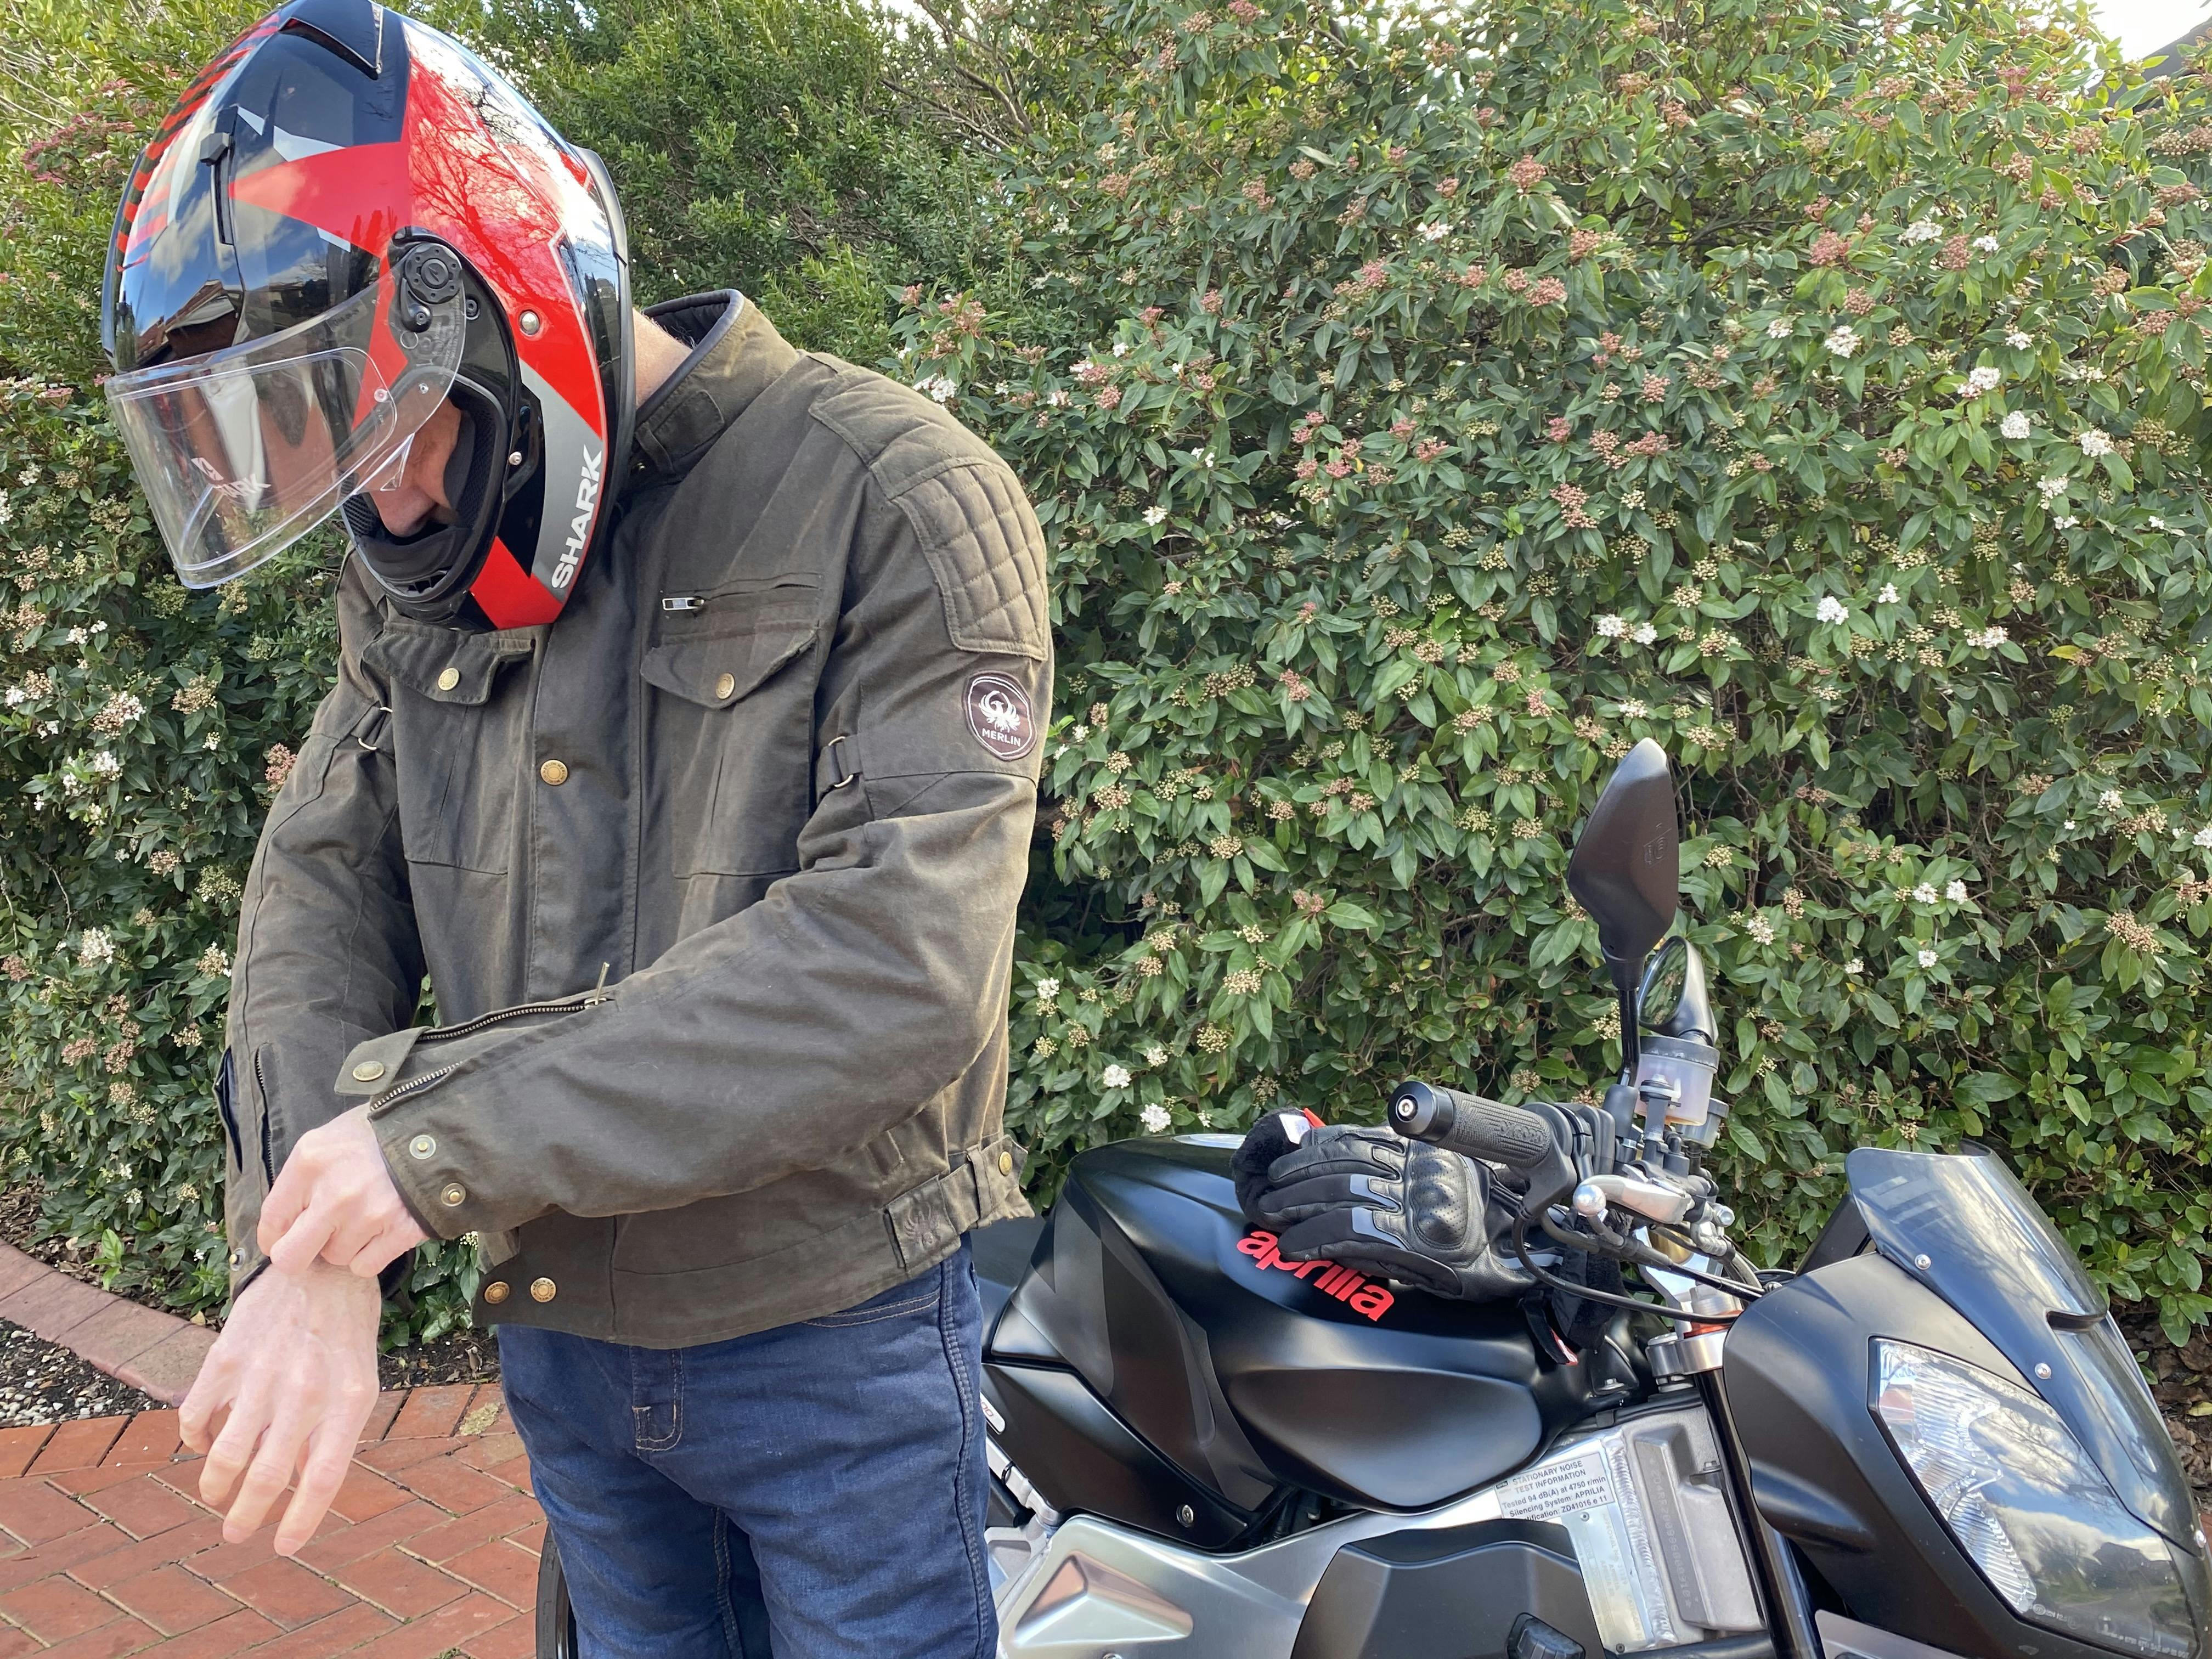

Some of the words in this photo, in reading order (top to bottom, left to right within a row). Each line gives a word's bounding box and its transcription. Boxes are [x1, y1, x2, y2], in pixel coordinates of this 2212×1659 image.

[551, 444, 602, 589] SHARK
[982, 728, 1021, 747] MERLIN
[1237, 1231, 1394, 1322] aprilia
[1513, 1468, 1558, 1486] STATIONARY
[1560, 1460, 1583, 1474] NOISE
[1516, 1483, 1536, 1494] TEST
[1536, 1469, 1586, 1488] INFORMATION
[1503, 1497, 1526, 1509] Tested
[1528, 1494, 1537, 1503] 94
[1538, 1489, 1559, 1500] dB(A)
[1569, 1481, 1585, 1491] 4750
[1587, 1476, 1606, 1486] r/min
[1509, 1502, 1544, 1517] Silencing
[1544, 1494, 1573, 1508] System:
[1575, 1486, 1605, 1499] APRILIA
[1523, 1509, 1560, 1521] tification:
